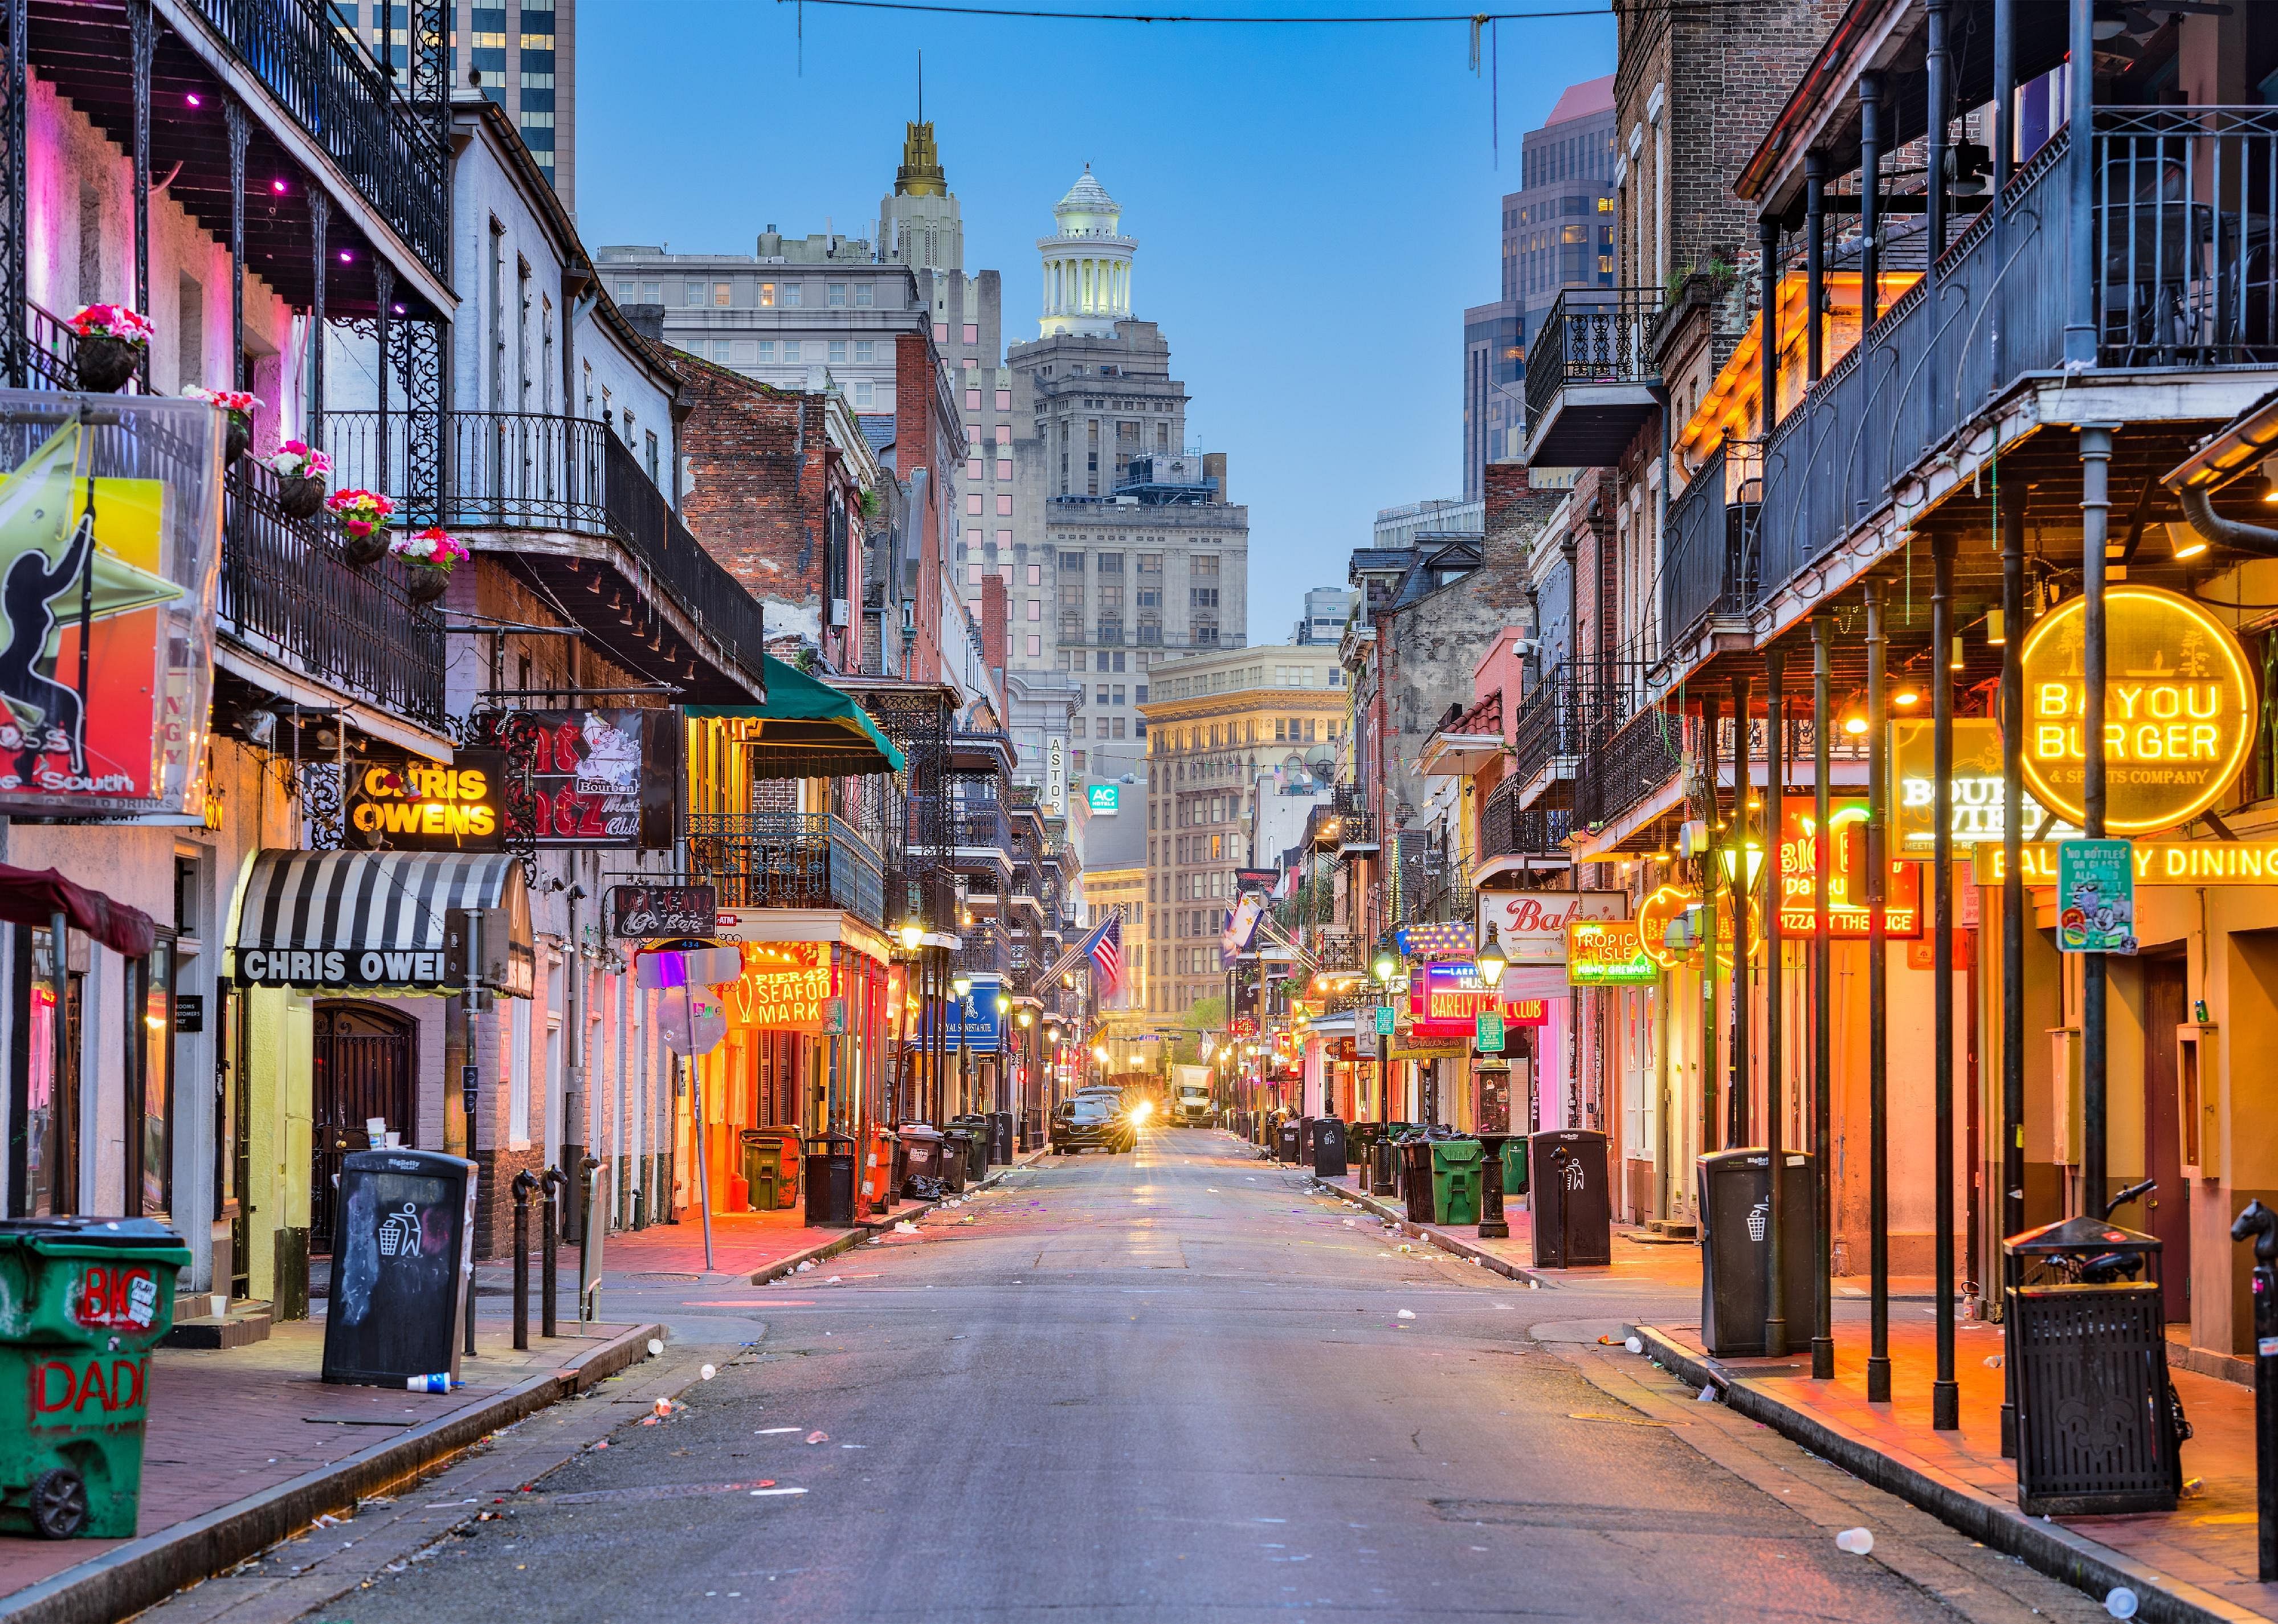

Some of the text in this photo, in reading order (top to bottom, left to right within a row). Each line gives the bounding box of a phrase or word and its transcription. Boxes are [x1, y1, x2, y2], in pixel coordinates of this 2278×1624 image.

[1051, 739, 1060, 813] ASTOR
[2066, 770, 2128, 784] SPTS
[2130, 768, 2210, 785] COMPANY
[580, 782, 635, 793] Bourbon
[1092, 789, 1115, 802] AC
[353, 803, 495, 835] OWENS
[1904, 842, 1936, 851] MEETIN
[2067, 850, 2126, 859] NO BOTTLES
[1993, 848, 2153, 878] BALY
[1504, 899, 1616, 932] Bab'
[1781, 914, 1816, 929] IZZA
[1839, 915, 1870, 930] THE
[1884, 915, 1912, 930] ICE
[1574, 933, 1639, 948] TROPIC
[1599, 947, 1631, 960] ISLE
[244, 950, 445, 982] CHRIS OWE
[1607, 965, 1652, 974] GRENADE
[755, 972, 802, 985] PIER
[1431, 993, 1473, 1018] BARELY
[1513, 1001, 1541, 1018] CLUB
[758, 1002, 820, 1025] MARK
[937, 1023, 992, 1032] RYAL SNESTA HOTEL
[387, 1158, 421, 1168] BigBelly
[37, 1358, 144, 1412] DAD
